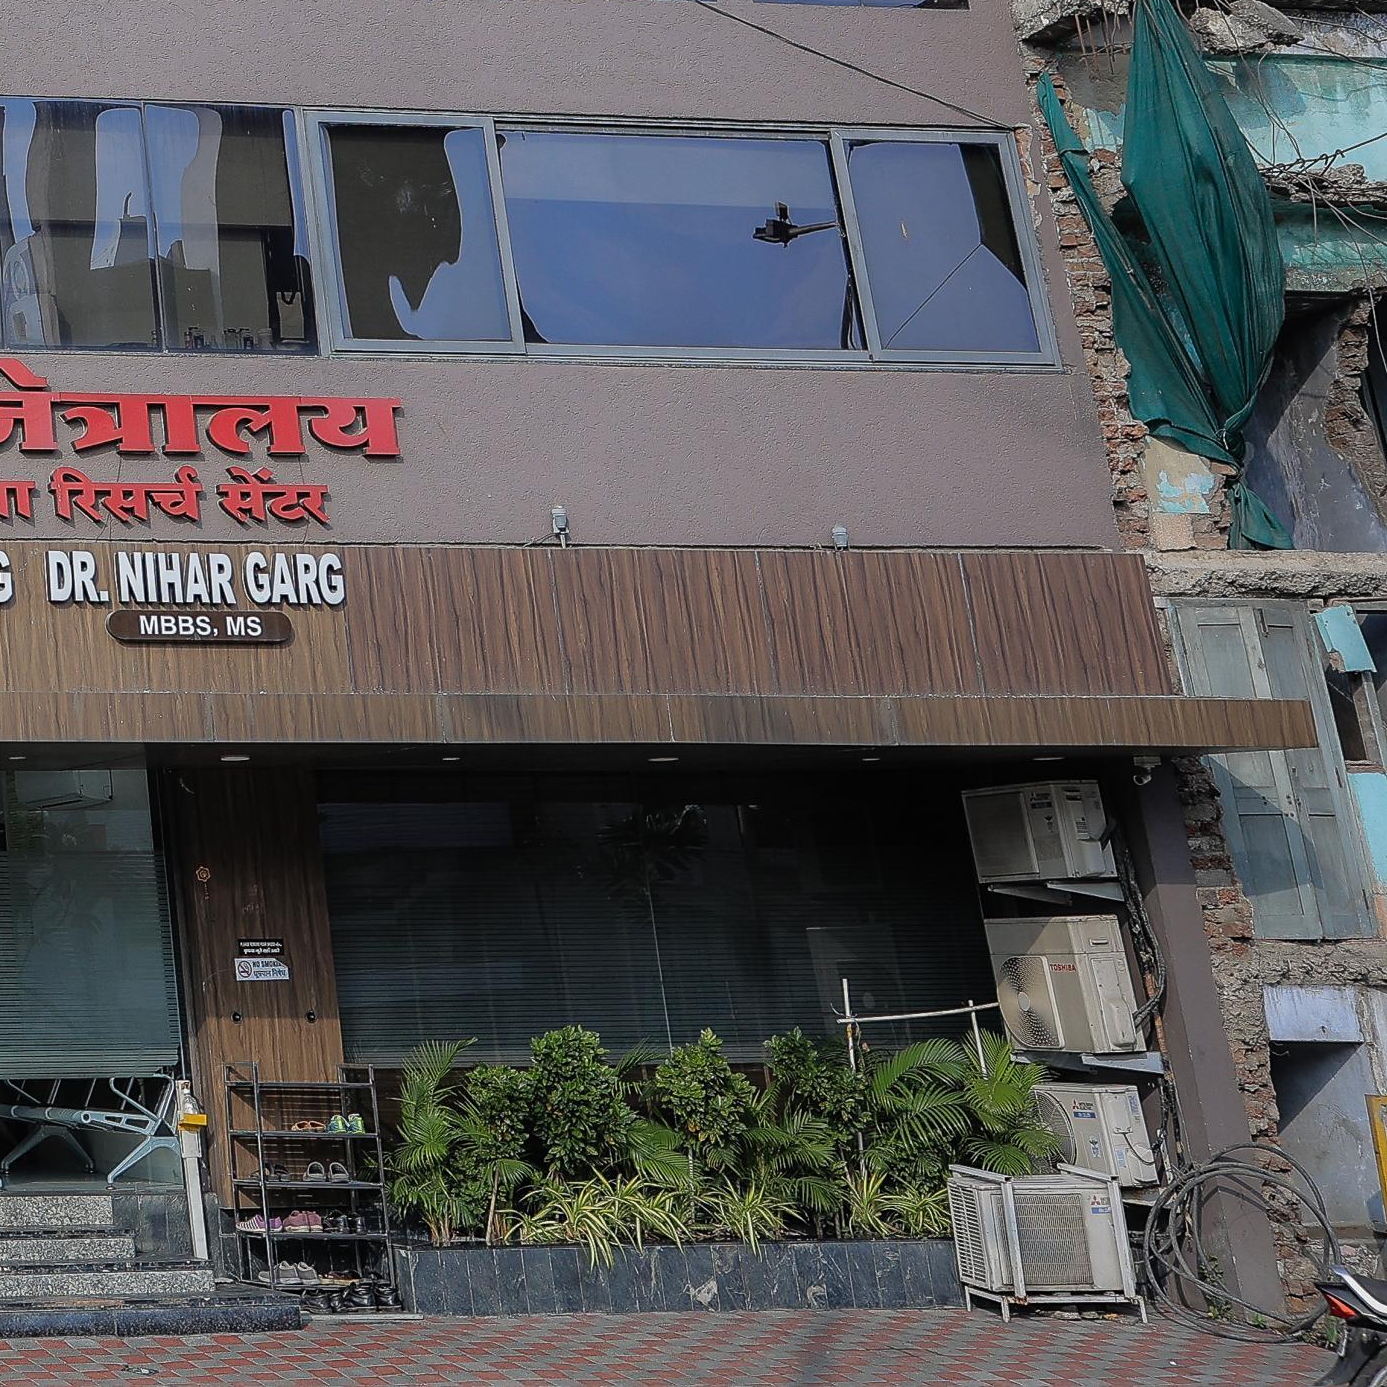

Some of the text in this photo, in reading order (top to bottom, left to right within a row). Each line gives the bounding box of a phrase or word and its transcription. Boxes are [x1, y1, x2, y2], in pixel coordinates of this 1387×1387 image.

[50, 465, 203, 520] रिसर्च
[220, 467, 329, 522] सेंटर
[48, 550, 346, 606] DR. NIHAR GARG
[139, 615, 262, 639] MBBS, MS
